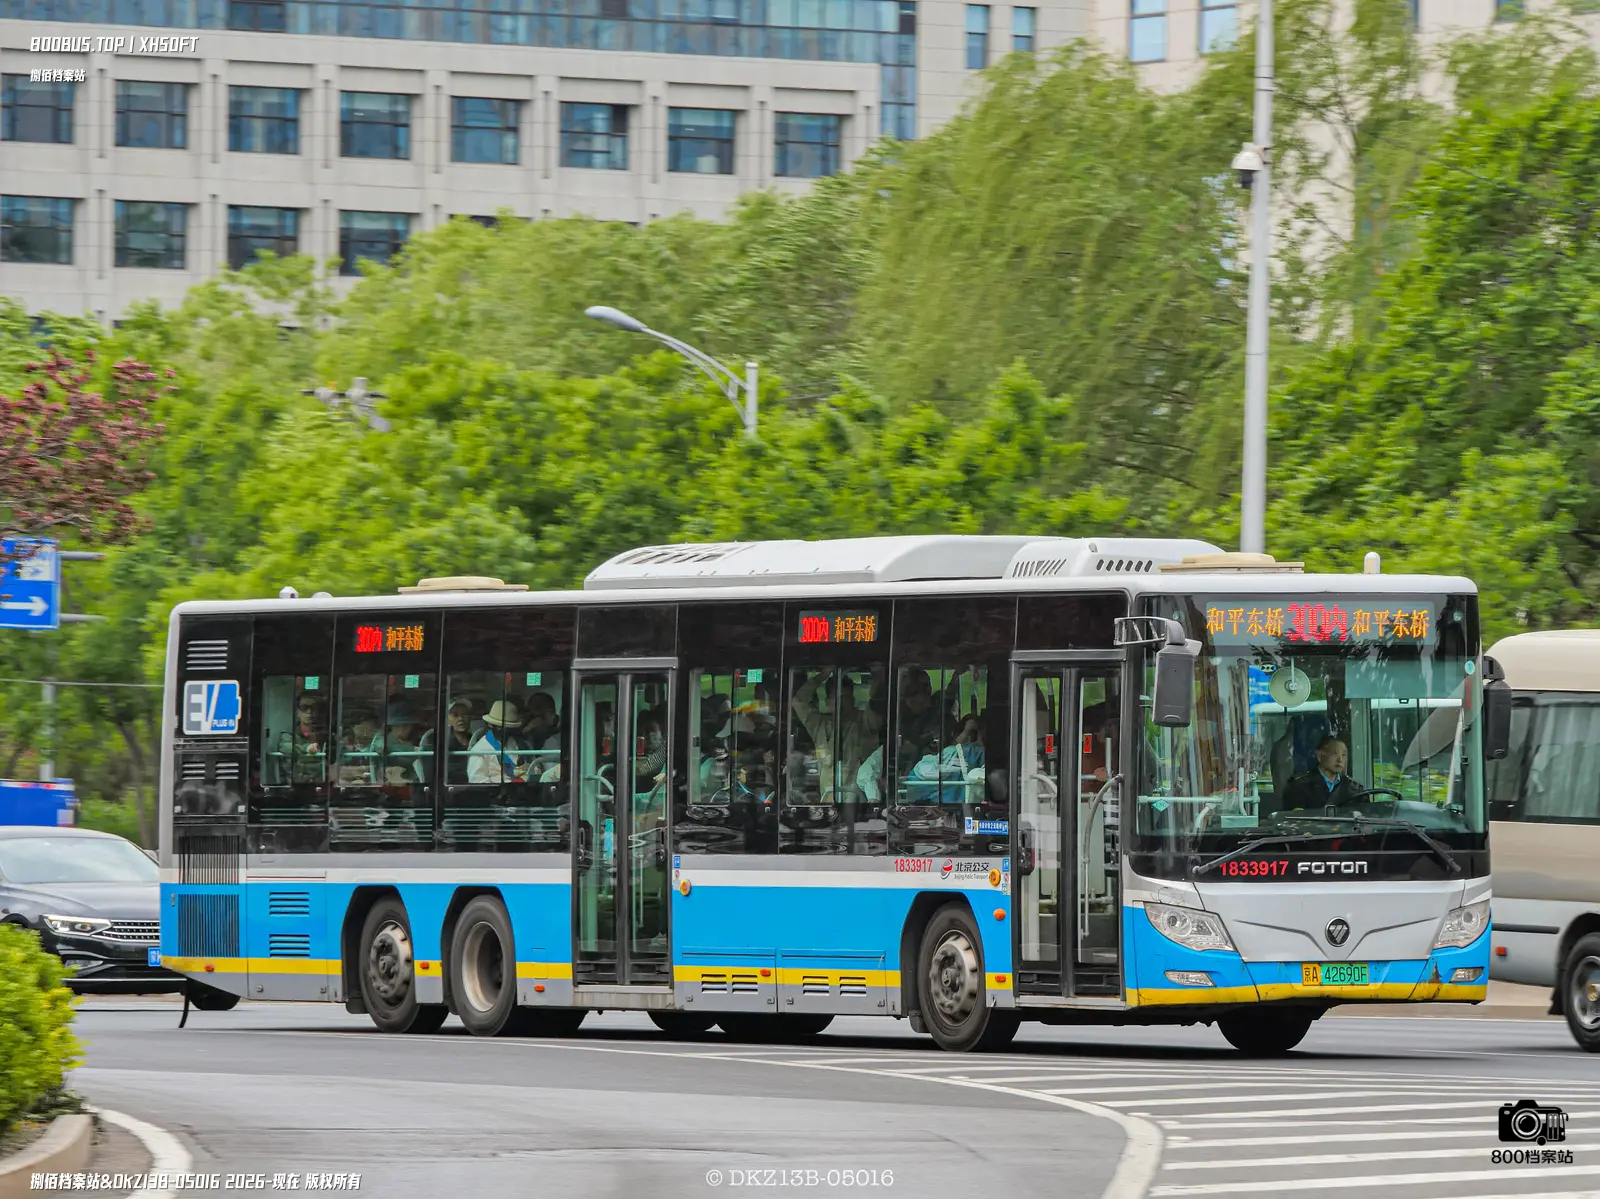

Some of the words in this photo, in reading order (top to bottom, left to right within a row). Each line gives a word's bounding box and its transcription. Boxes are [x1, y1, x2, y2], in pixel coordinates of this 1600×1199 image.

[834, 615, 876, 643] 和平东桥
[1206, 607, 1285, 636] 和平东桥
[1287, 602, 1348, 642] 300内
[1352, 608, 1430, 639] 和平东桥
[386, 625, 424, 652] 和平东桥
[894, 858, 933, 873] 1833917
[955, 862, 990, 872] 北京公交
[1219, 861, 1289, 876] 1833917
[1297, 861, 1368, 875] FOTON
[1324, 966, 1367, 982] 42690F
